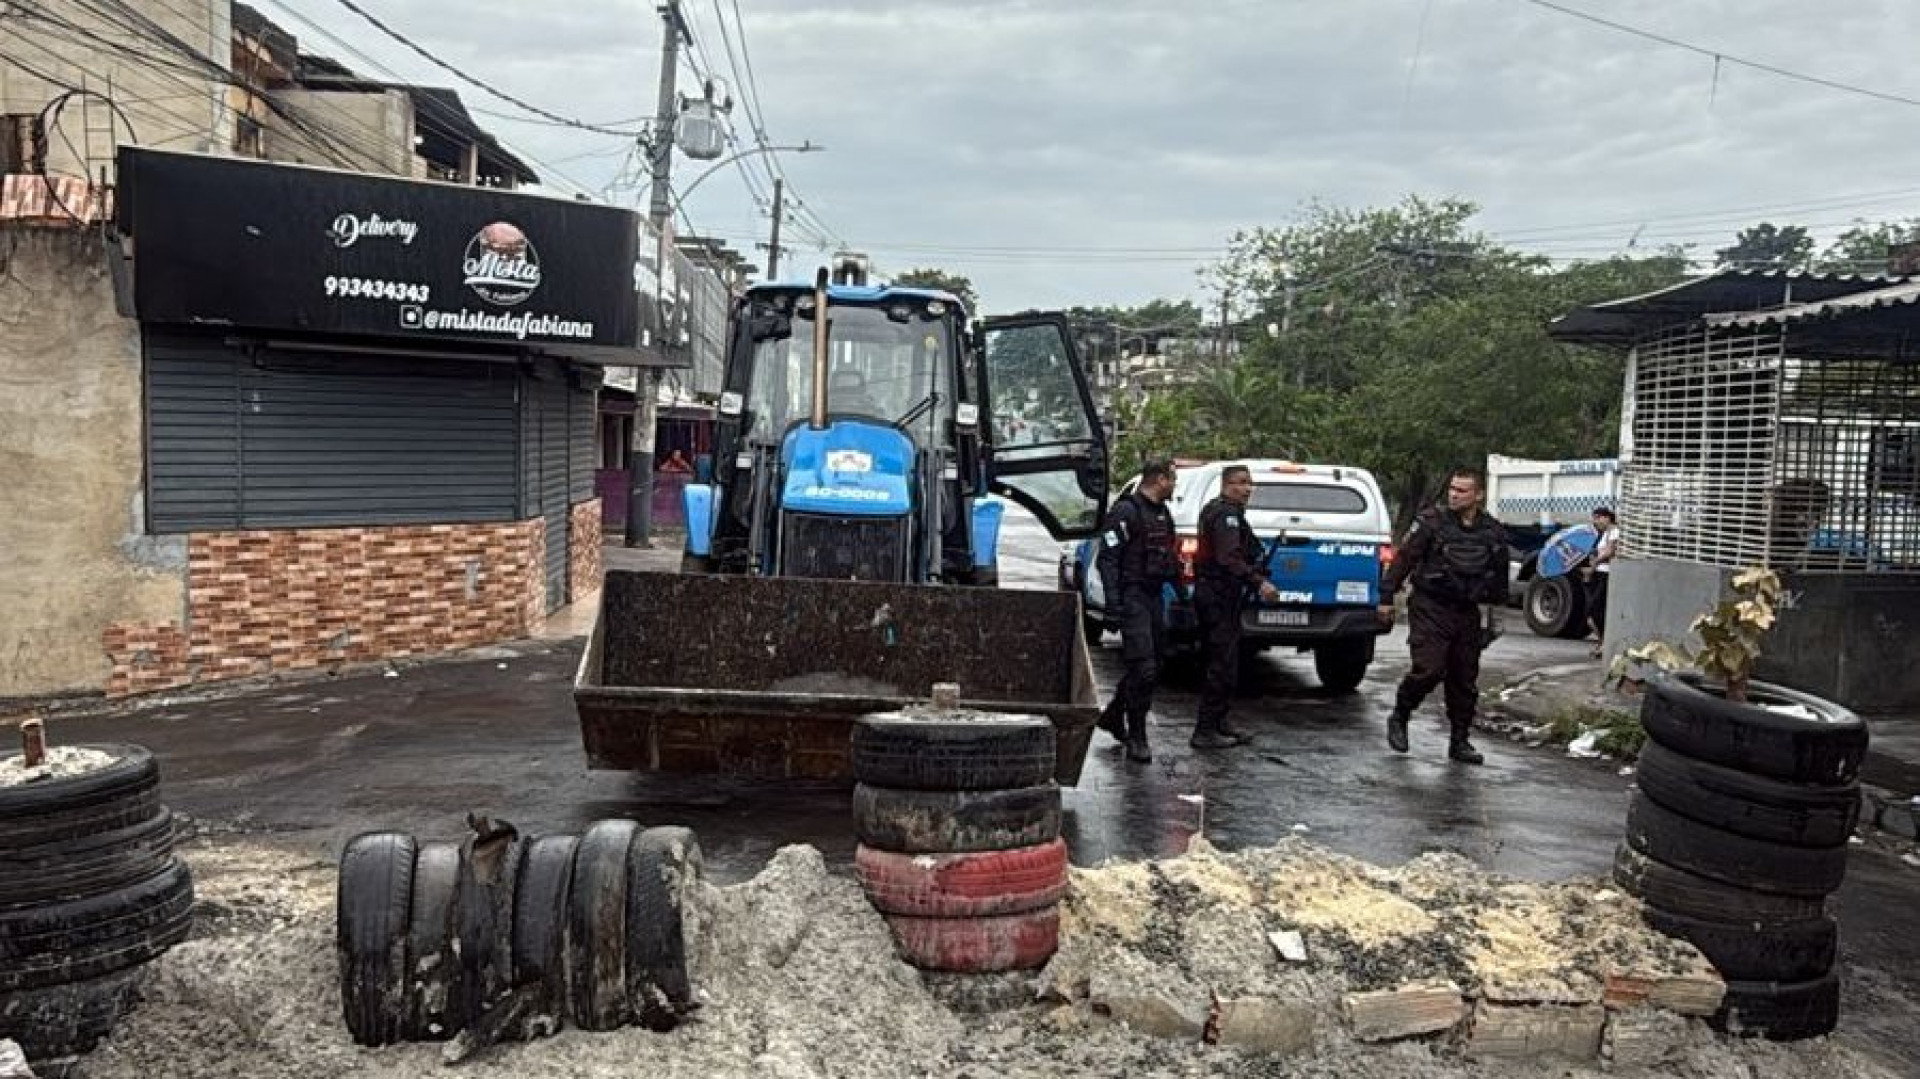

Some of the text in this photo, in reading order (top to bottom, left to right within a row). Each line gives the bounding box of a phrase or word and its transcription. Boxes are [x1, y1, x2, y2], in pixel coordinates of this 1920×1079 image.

[327, 213, 418, 247] Delivery
[463, 249, 540, 286] Mista
[324, 275, 429, 303] 993434343
